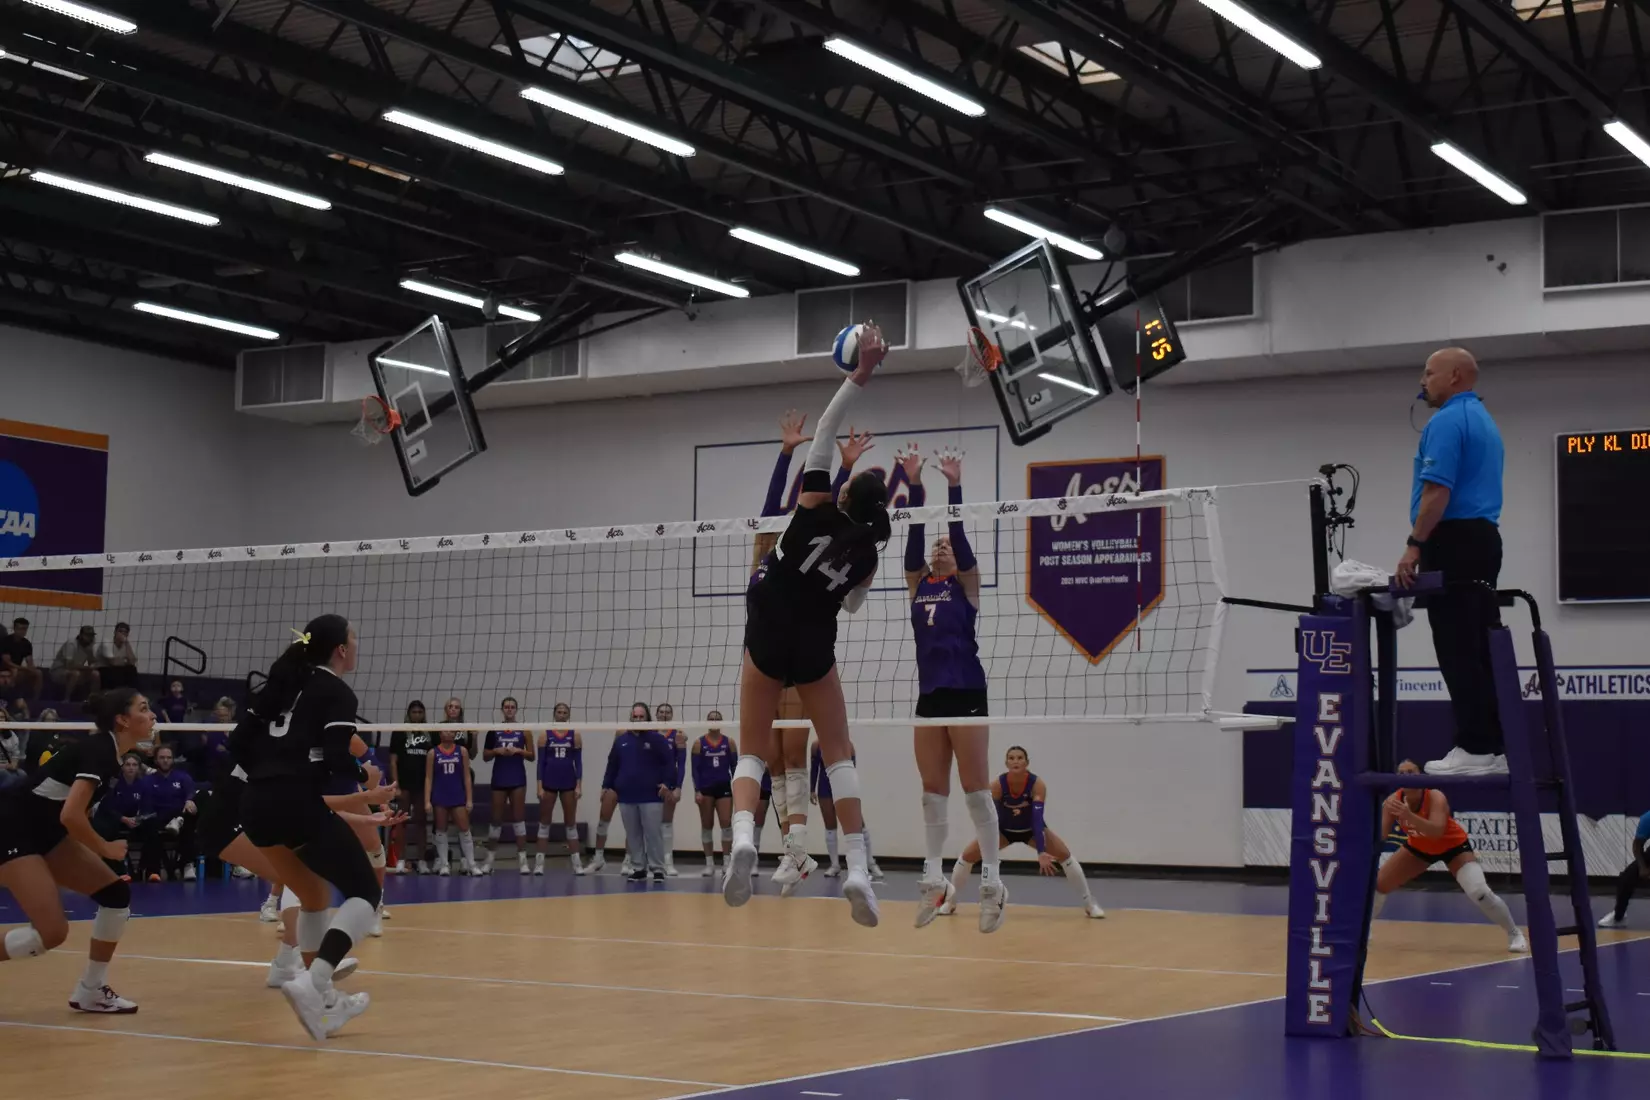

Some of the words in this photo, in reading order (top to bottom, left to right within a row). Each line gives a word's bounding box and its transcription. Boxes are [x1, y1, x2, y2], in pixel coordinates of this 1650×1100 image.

[1029, 392, 1042, 405] 3
[1567, 436, 1595, 454] PLY
[1604, 434, 1622, 451] KL
[1631, 432, 1650, 450] DI
[410, 448, 421, 458] 1
[519, 532, 536, 544] Aces
[606, 527, 625, 539] Aces
[696, 521, 716, 533] Aces
[747, 518, 760, 530] UE
[890, 509, 912, 522] Aces
[947, 505, 961, 518] UE
[997, 501, 1020, 515] Aces
[1106, 494, 1128, 507] Aces
[1051, 540, 1089, 552] WOMEN'S
[1091, 538, 1138, 551] VOLLEYBALL
[798, 534, 853, 592] 14
[1039, 555, 1060, 567] POST
[1061, 553, 1093, 566] SEASON
[924, 603, 937, 627] 7
[1302, 630, 1352, 674] UE
[1396, 678, 1444, 692] incent
[443, 763, 456, 775] 10
[712, 756, 720, 768] 6
[1456, 818, 1518, 835] TATE
[1306, 691, 1345, 1025] EVANSVILLE
